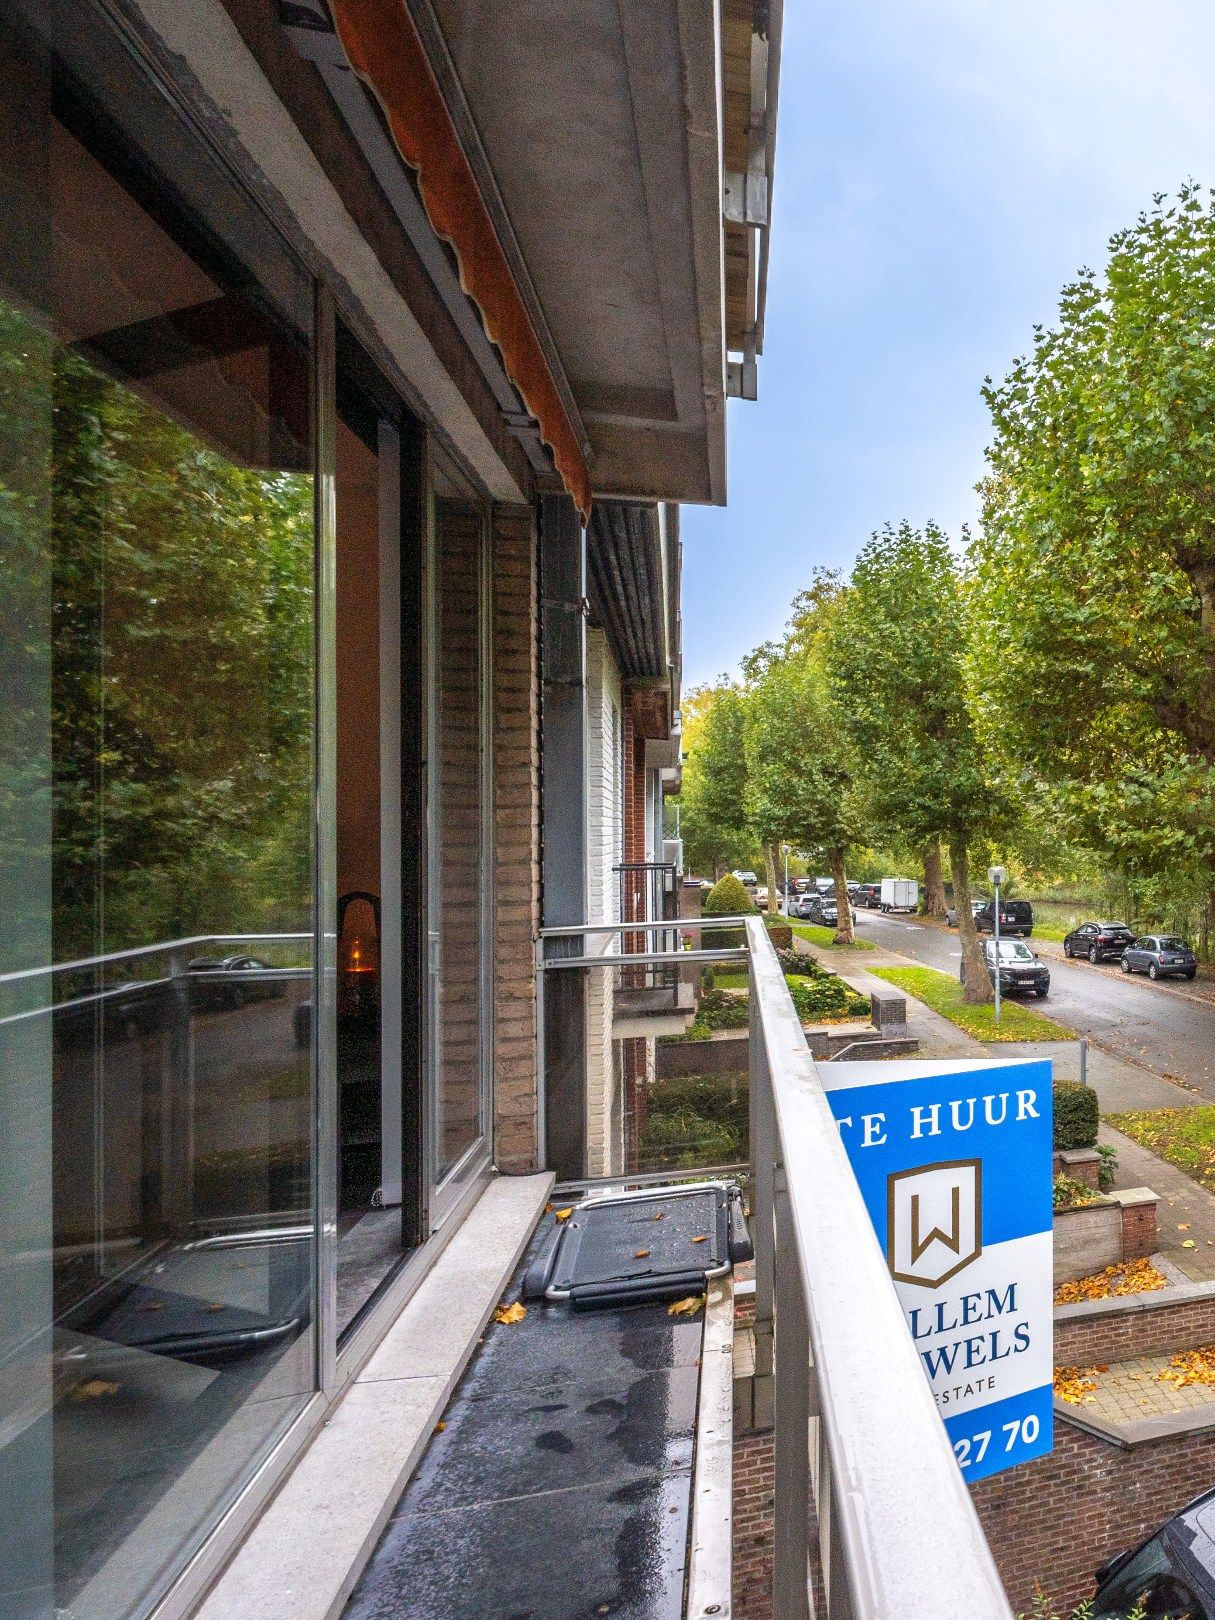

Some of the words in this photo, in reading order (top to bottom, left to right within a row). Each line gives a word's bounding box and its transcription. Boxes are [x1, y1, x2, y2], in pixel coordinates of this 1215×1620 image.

[909, 1089, 1041, 1139] HUUR
[911, 1186, 960, 1267] W
[909, 1282, 1018, 1340] LLEM
[921, 1321, 1031, 1380] WELS
[953, 1430, 992, 1469] 27
[1002, 1414, 1040, 1452] 70
